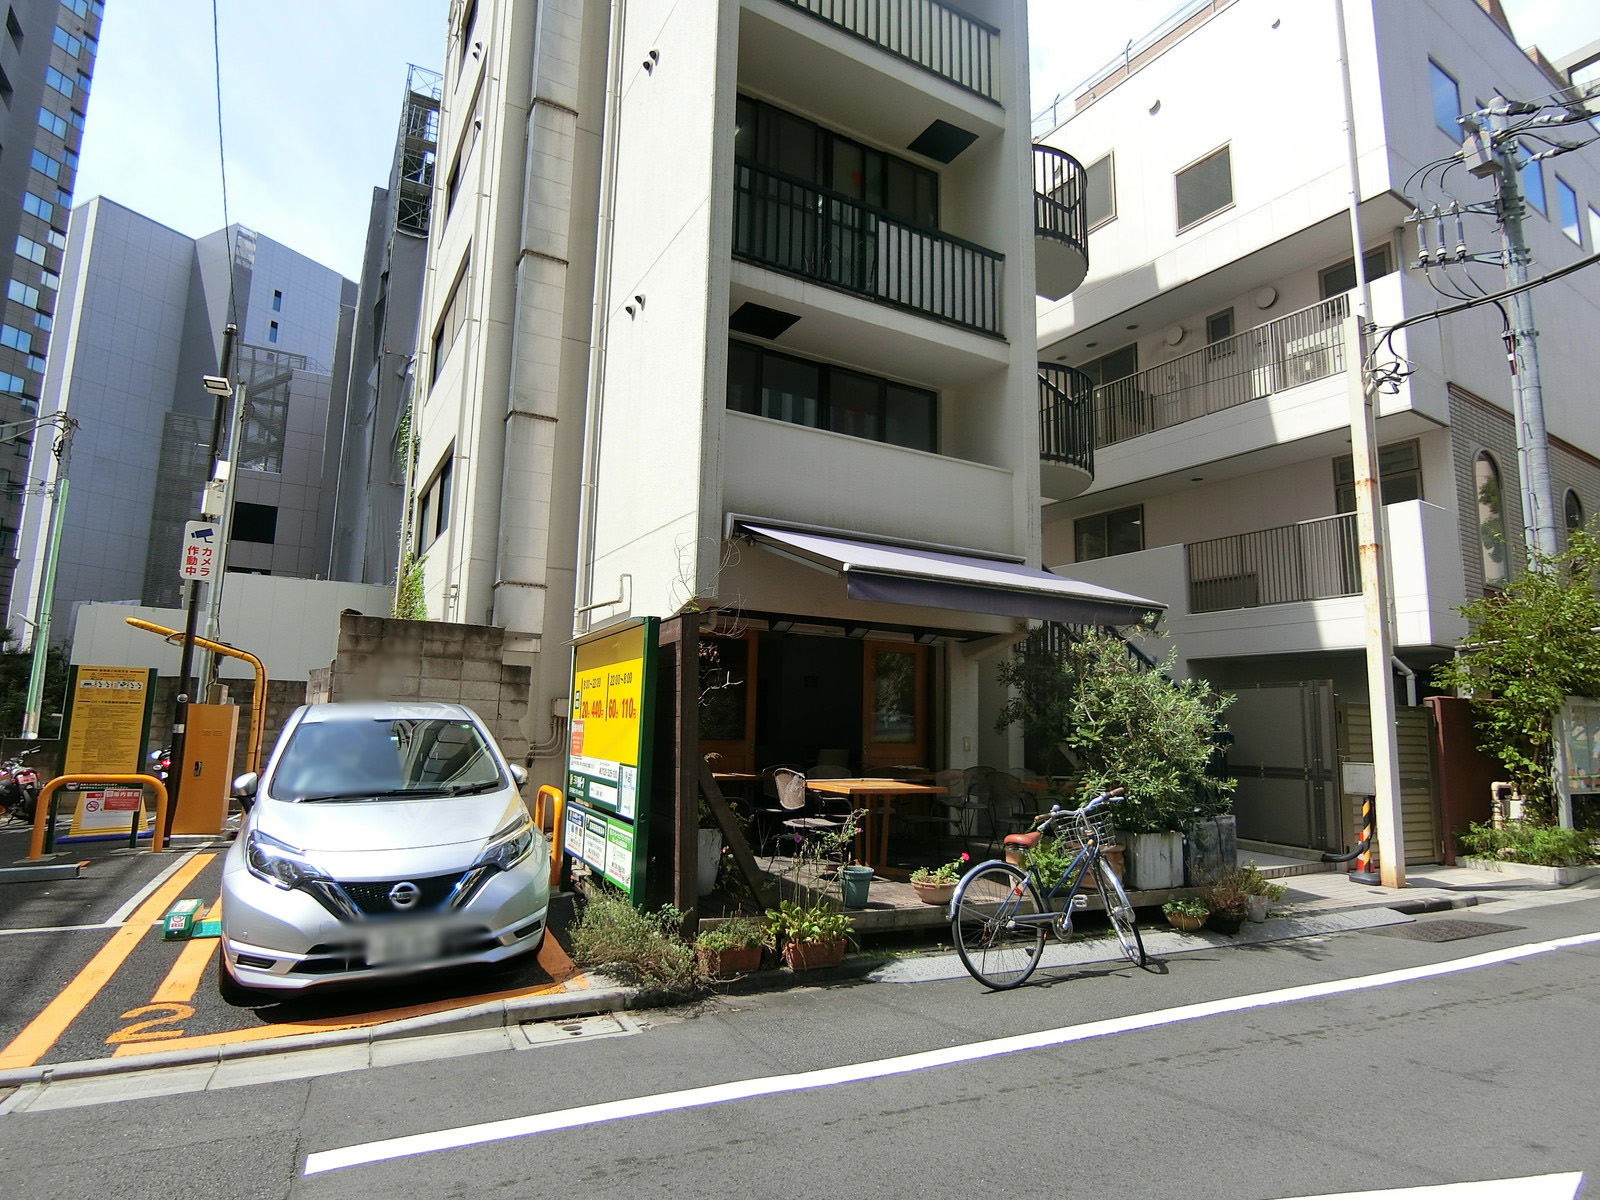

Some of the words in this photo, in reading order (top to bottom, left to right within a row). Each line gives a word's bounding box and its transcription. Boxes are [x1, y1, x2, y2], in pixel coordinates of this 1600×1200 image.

[185, 545, 200, 576] 作動中
[200, 547, 213, 577] カメラ
[104, 1003, 196, 1045] 2
